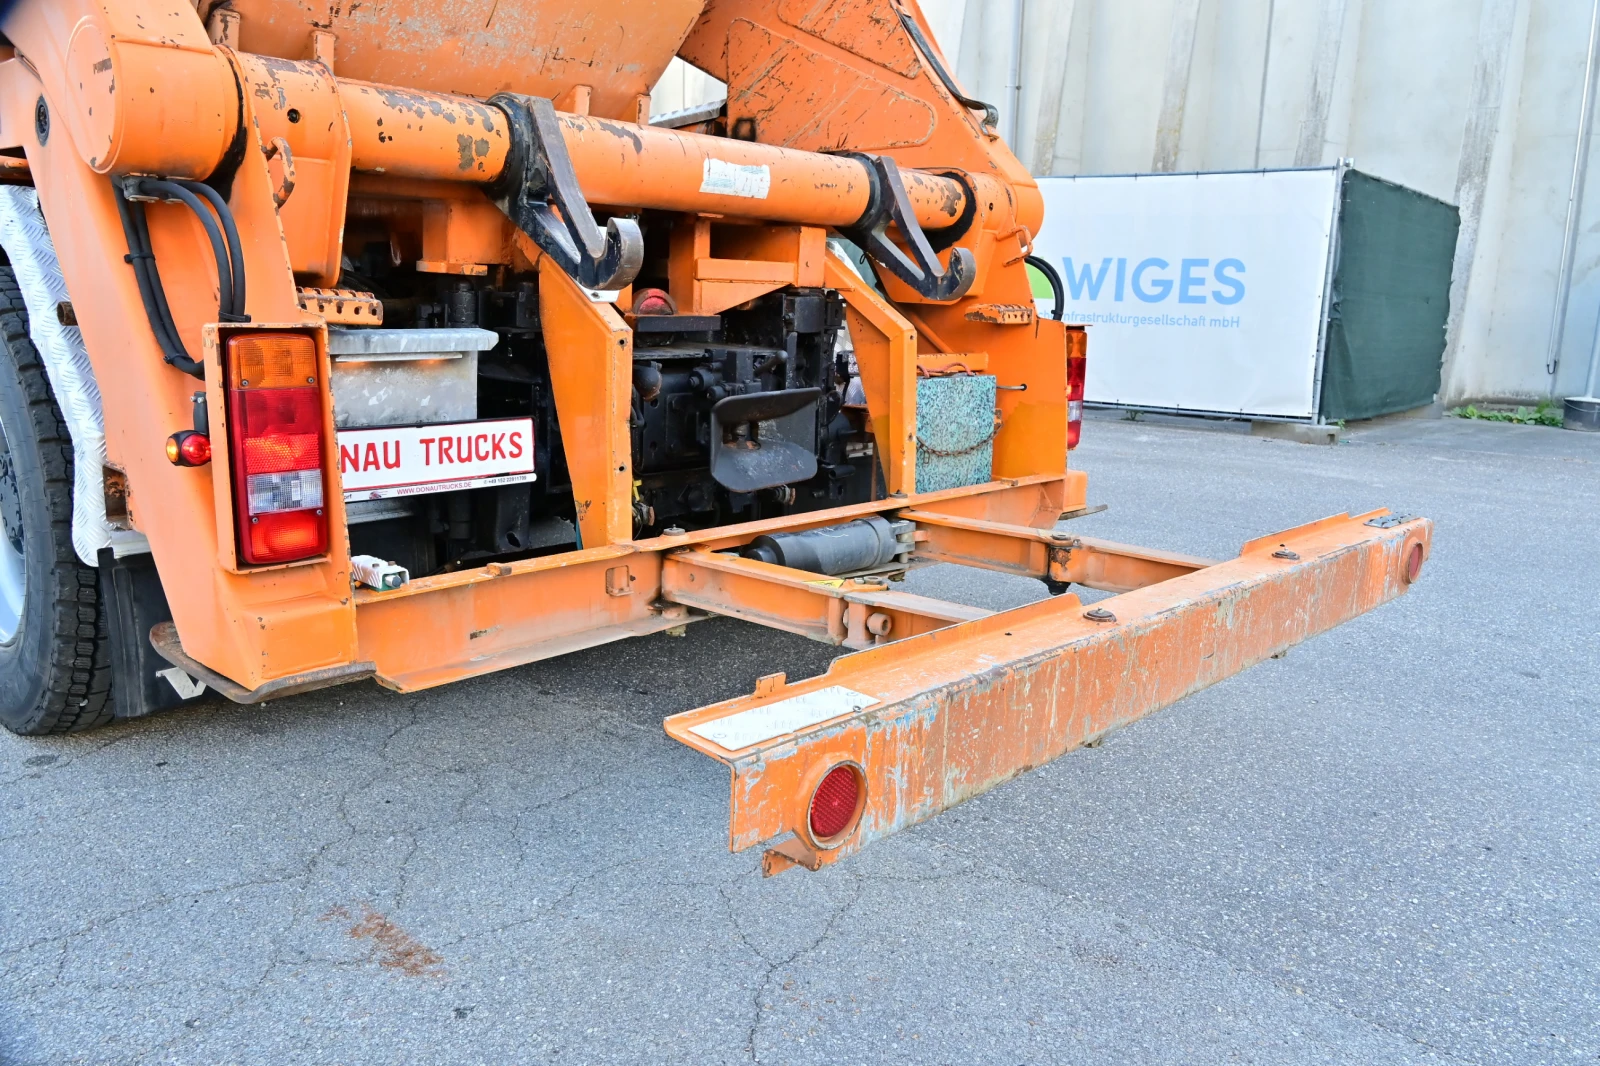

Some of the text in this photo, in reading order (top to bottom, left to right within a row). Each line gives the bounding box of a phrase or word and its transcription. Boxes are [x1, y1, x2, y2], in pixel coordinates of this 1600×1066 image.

[1062, 256, 1247, 305] WIGES
[1063, 310, 1206, 328] nfrastrukturgesellschaft
[1209, 315, 1241, 328] mbH
[340, 431, 523, 473] NAU TRUCKS
[397, 481, 472, 495] WWW.DONAUTRUCKS.DE
